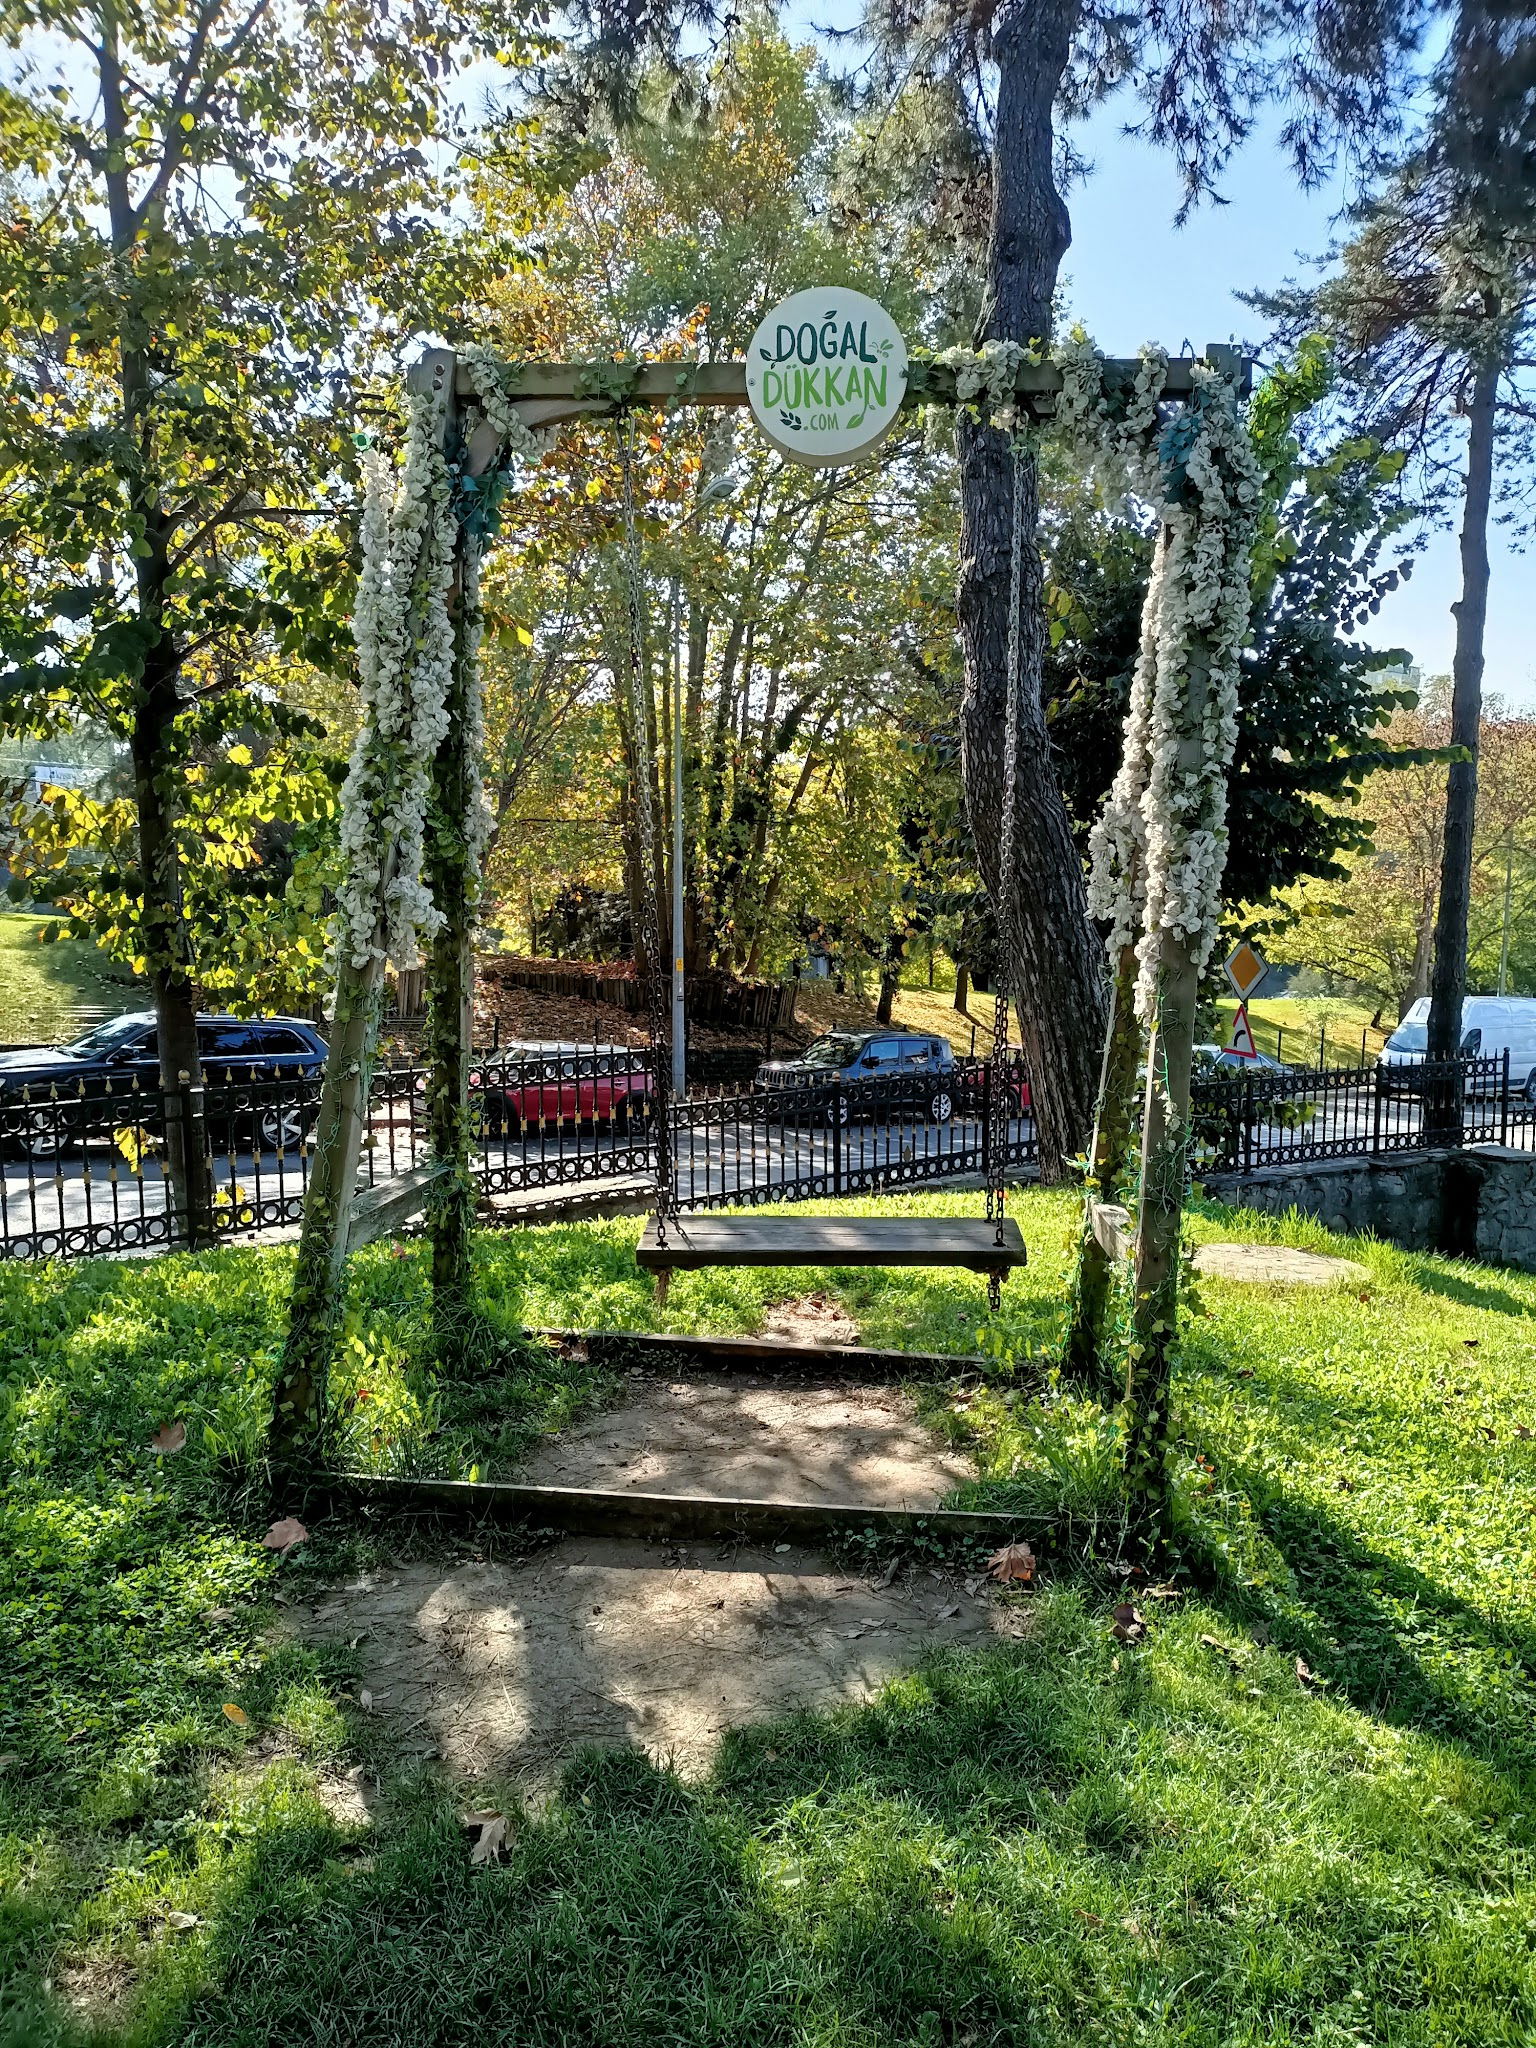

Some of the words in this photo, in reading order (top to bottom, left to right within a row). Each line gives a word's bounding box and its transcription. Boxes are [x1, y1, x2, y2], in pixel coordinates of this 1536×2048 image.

[776, 310, 878, 365] DOĞAL
[763, 363, 887, 410] DÜKKAN
[803, 412, 839, 431] .COM
